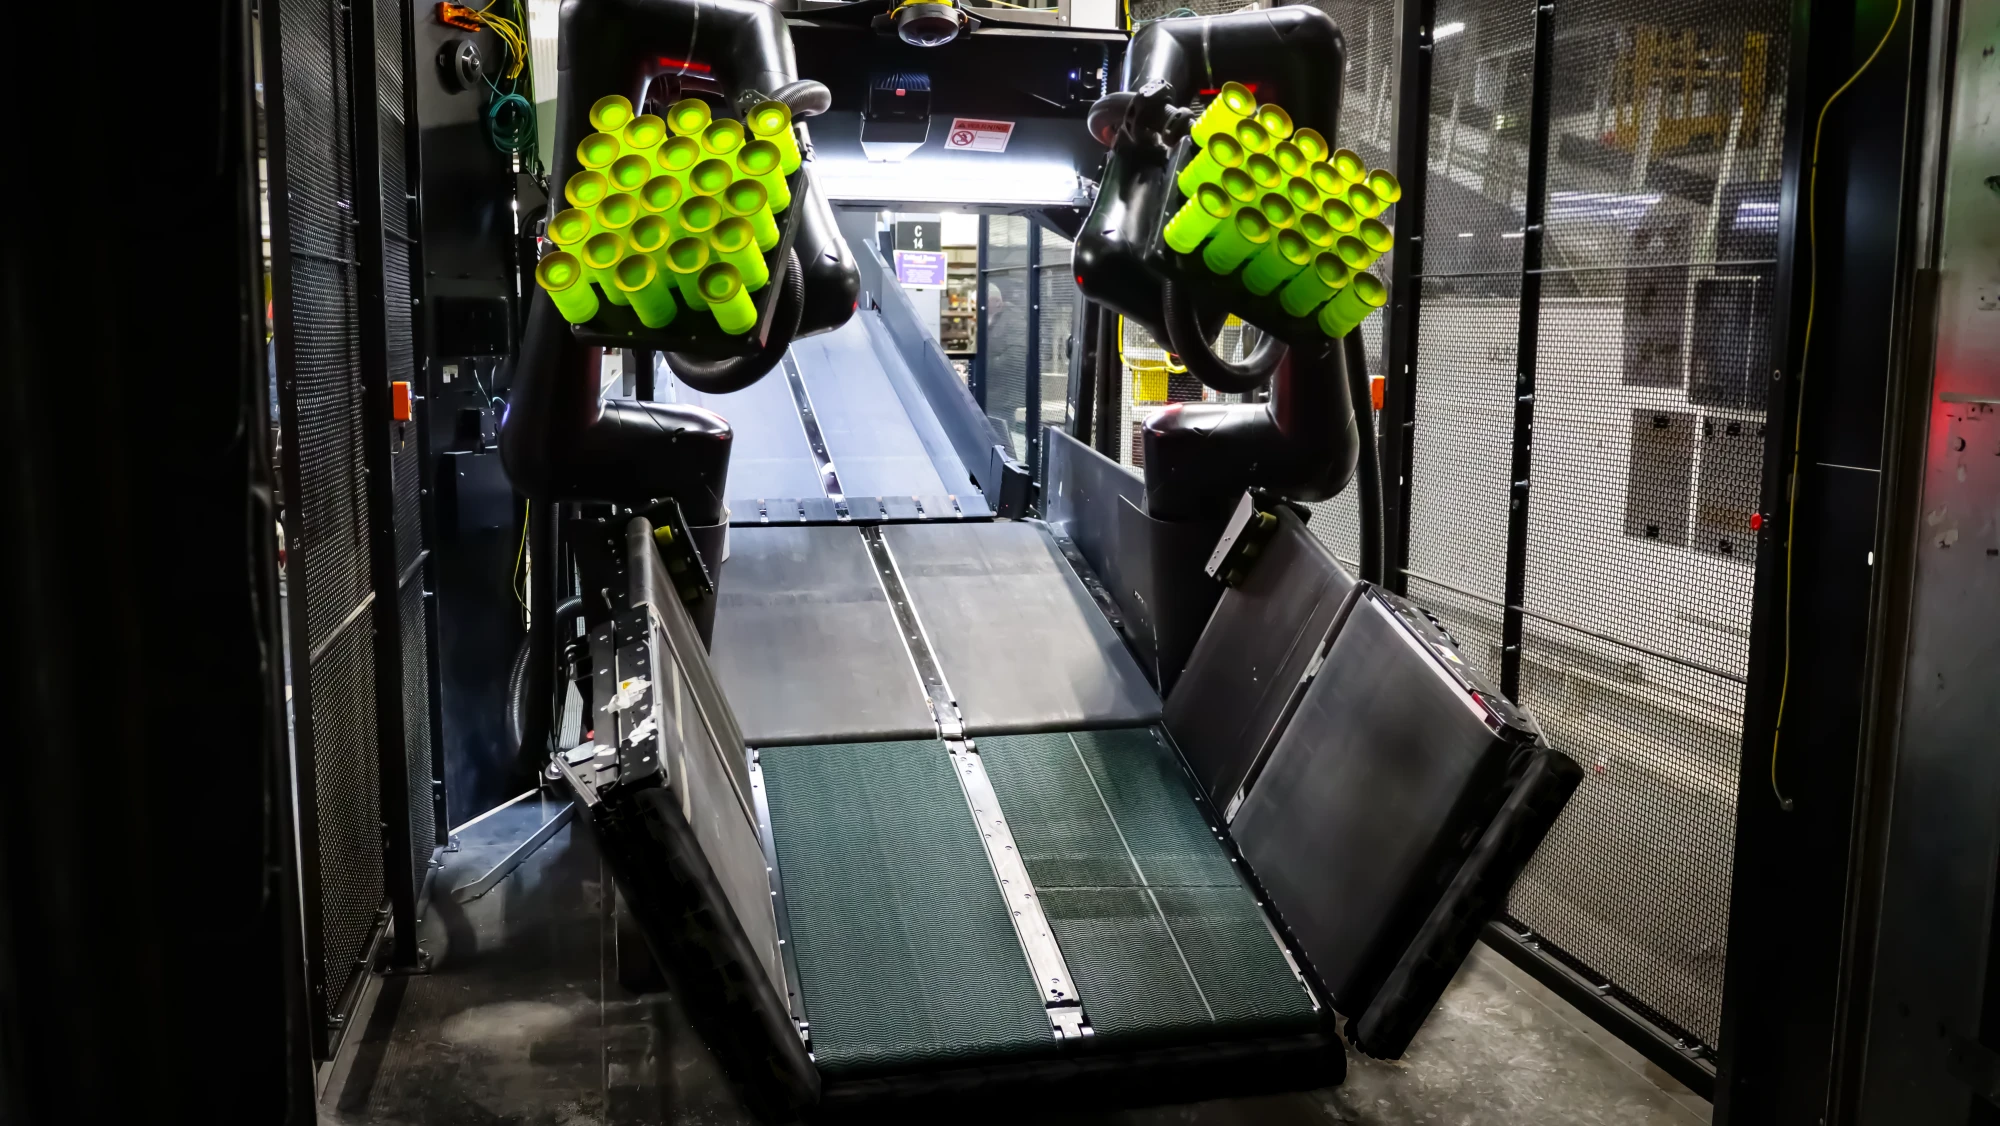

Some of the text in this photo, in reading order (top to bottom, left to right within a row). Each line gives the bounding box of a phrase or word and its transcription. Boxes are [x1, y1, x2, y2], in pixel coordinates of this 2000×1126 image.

[967, 122, 1008, 131] WARNING
[914, 225, 922, 237] C
[913, 238, 923, 249] 14
